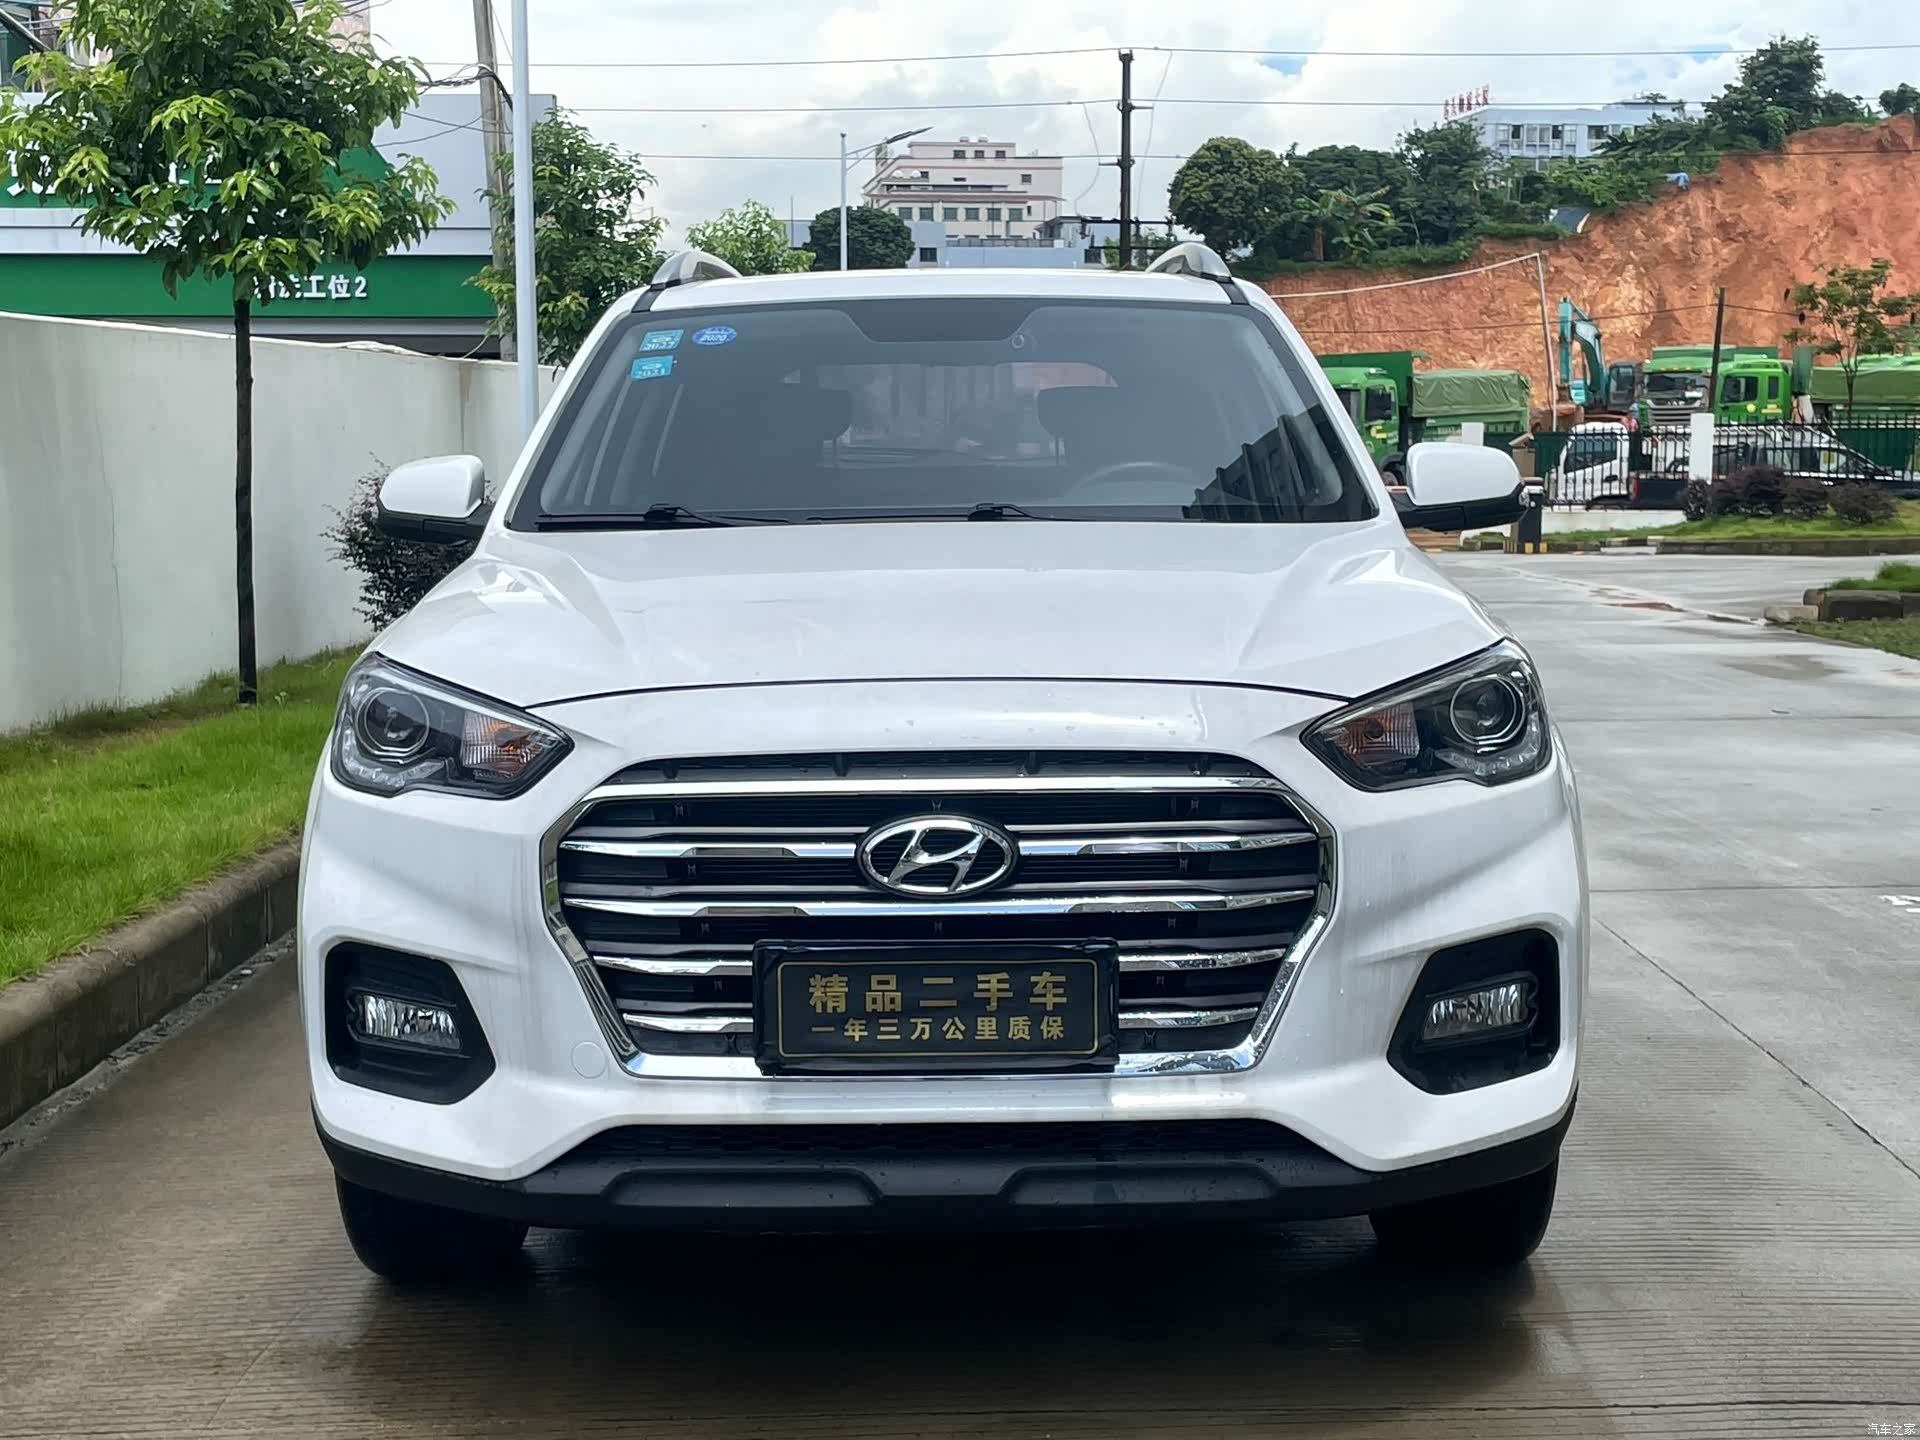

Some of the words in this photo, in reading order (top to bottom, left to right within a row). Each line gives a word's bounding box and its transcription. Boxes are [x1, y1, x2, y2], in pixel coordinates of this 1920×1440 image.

[809, 971, 1067, 1013] 精品二手车
[811, 1016, 1064, 1042] 一年三万公里质保
